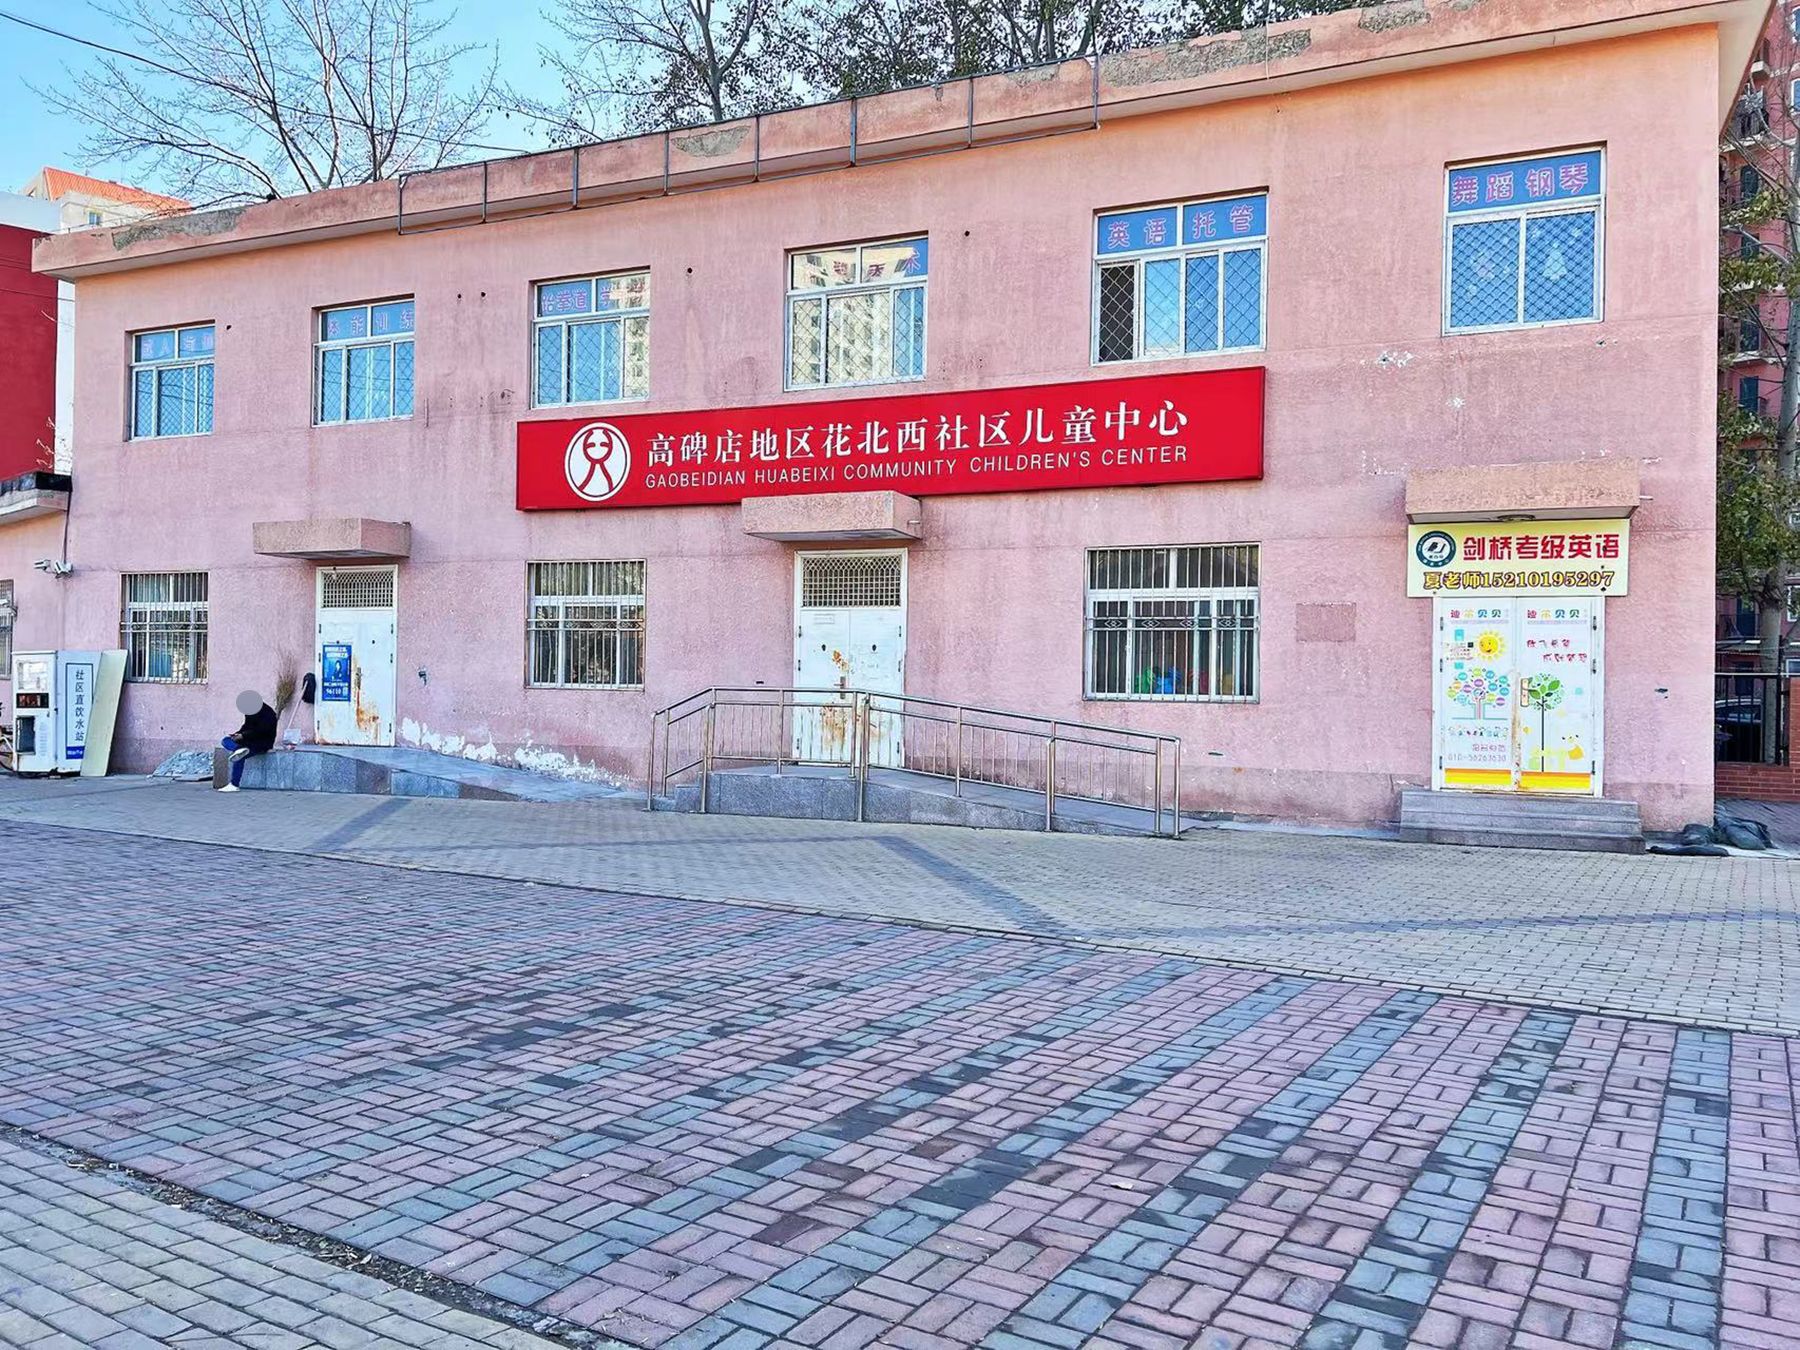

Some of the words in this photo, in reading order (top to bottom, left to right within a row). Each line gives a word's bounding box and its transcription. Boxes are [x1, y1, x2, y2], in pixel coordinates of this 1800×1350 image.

[646, 400, 1188, 468] 高碑店地区花北西社区儿童中心
[645, 470, 746, 488] GAOBEIDIAN
[754, 466, 835, 483] HUABEIXI
[843, 459, 957, 480] COMMUNITY
[969, 451, 1091, 473] CHILDREN'S
[1101, 445, 1187, 466] CENTER
[1463, 534, 1620, 561] 剑桥考级英语
[75, 668, 86, 742] 社区直饮水站
